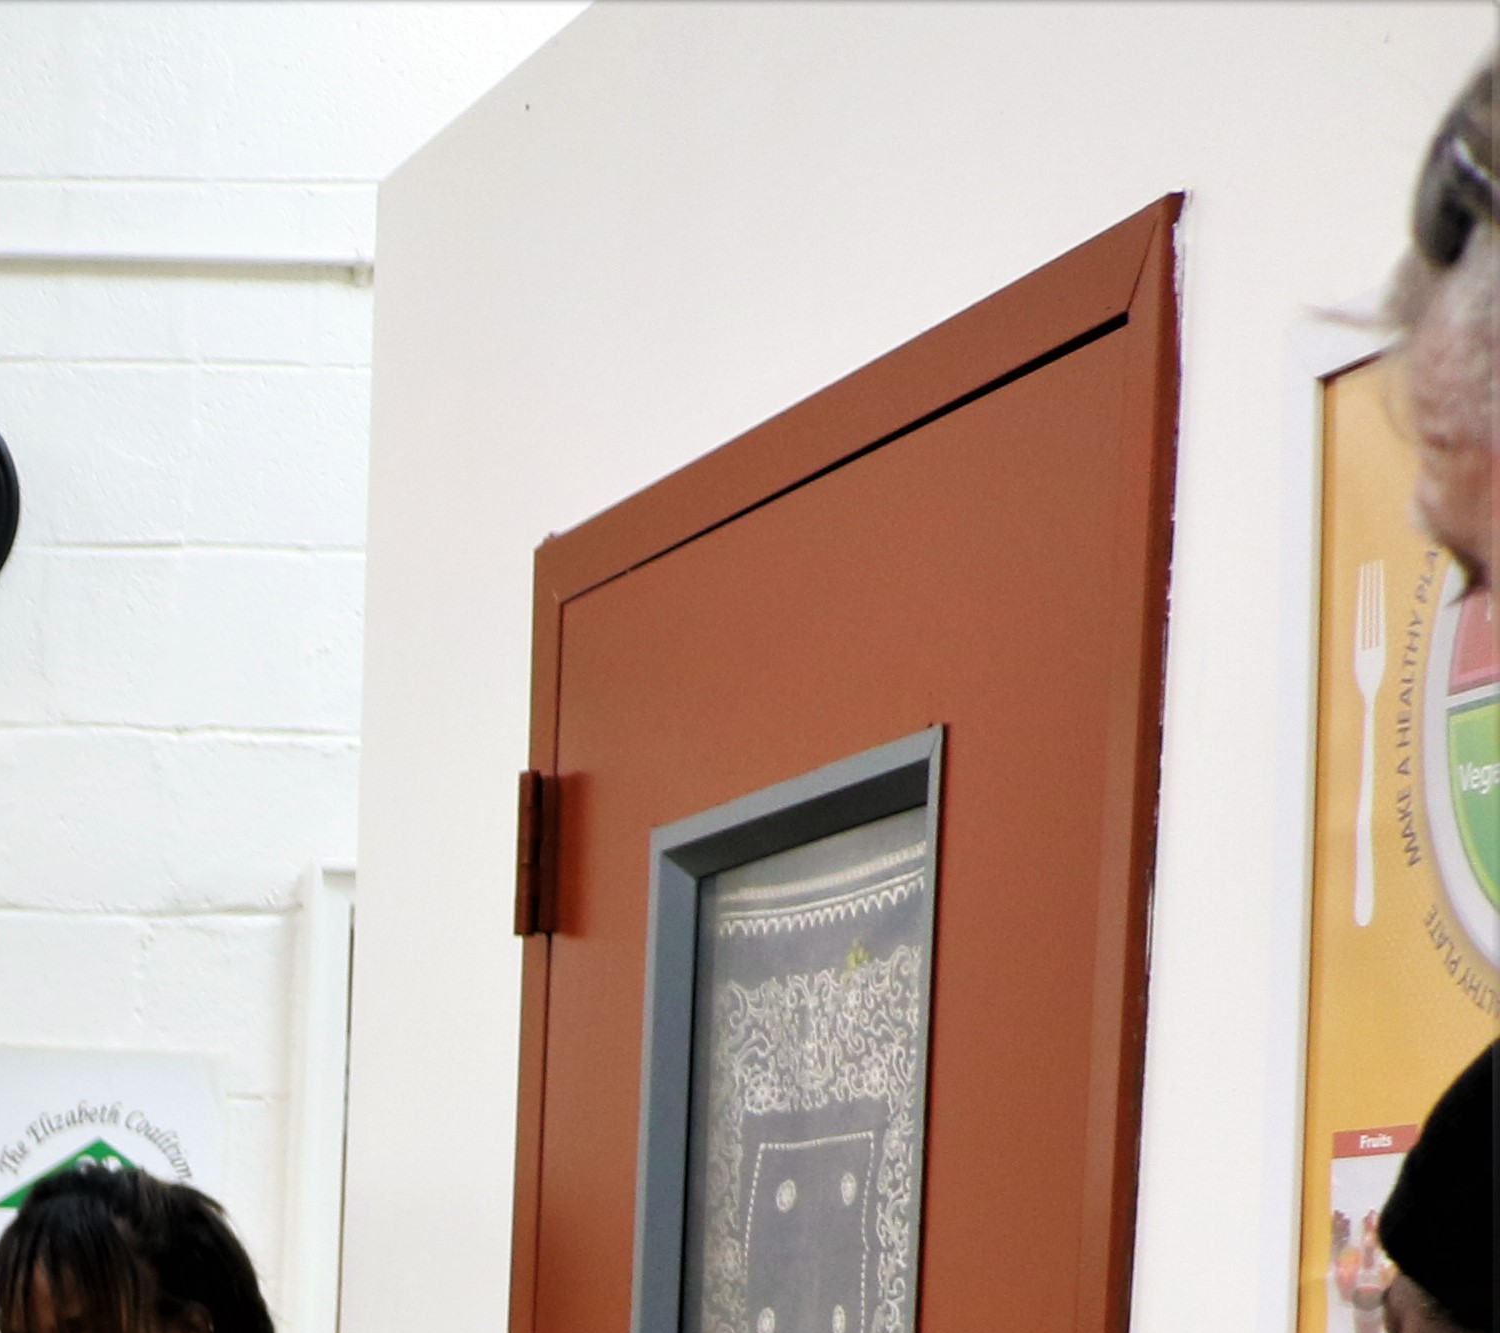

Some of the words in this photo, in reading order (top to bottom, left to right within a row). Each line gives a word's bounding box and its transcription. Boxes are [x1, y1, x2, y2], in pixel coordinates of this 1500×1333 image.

[1397, 616, 1424, 748] HEALTHY
[26, 1099, 123, 1146] Elizabeth
[1359, 1133, 1393, 1150] Fruits
